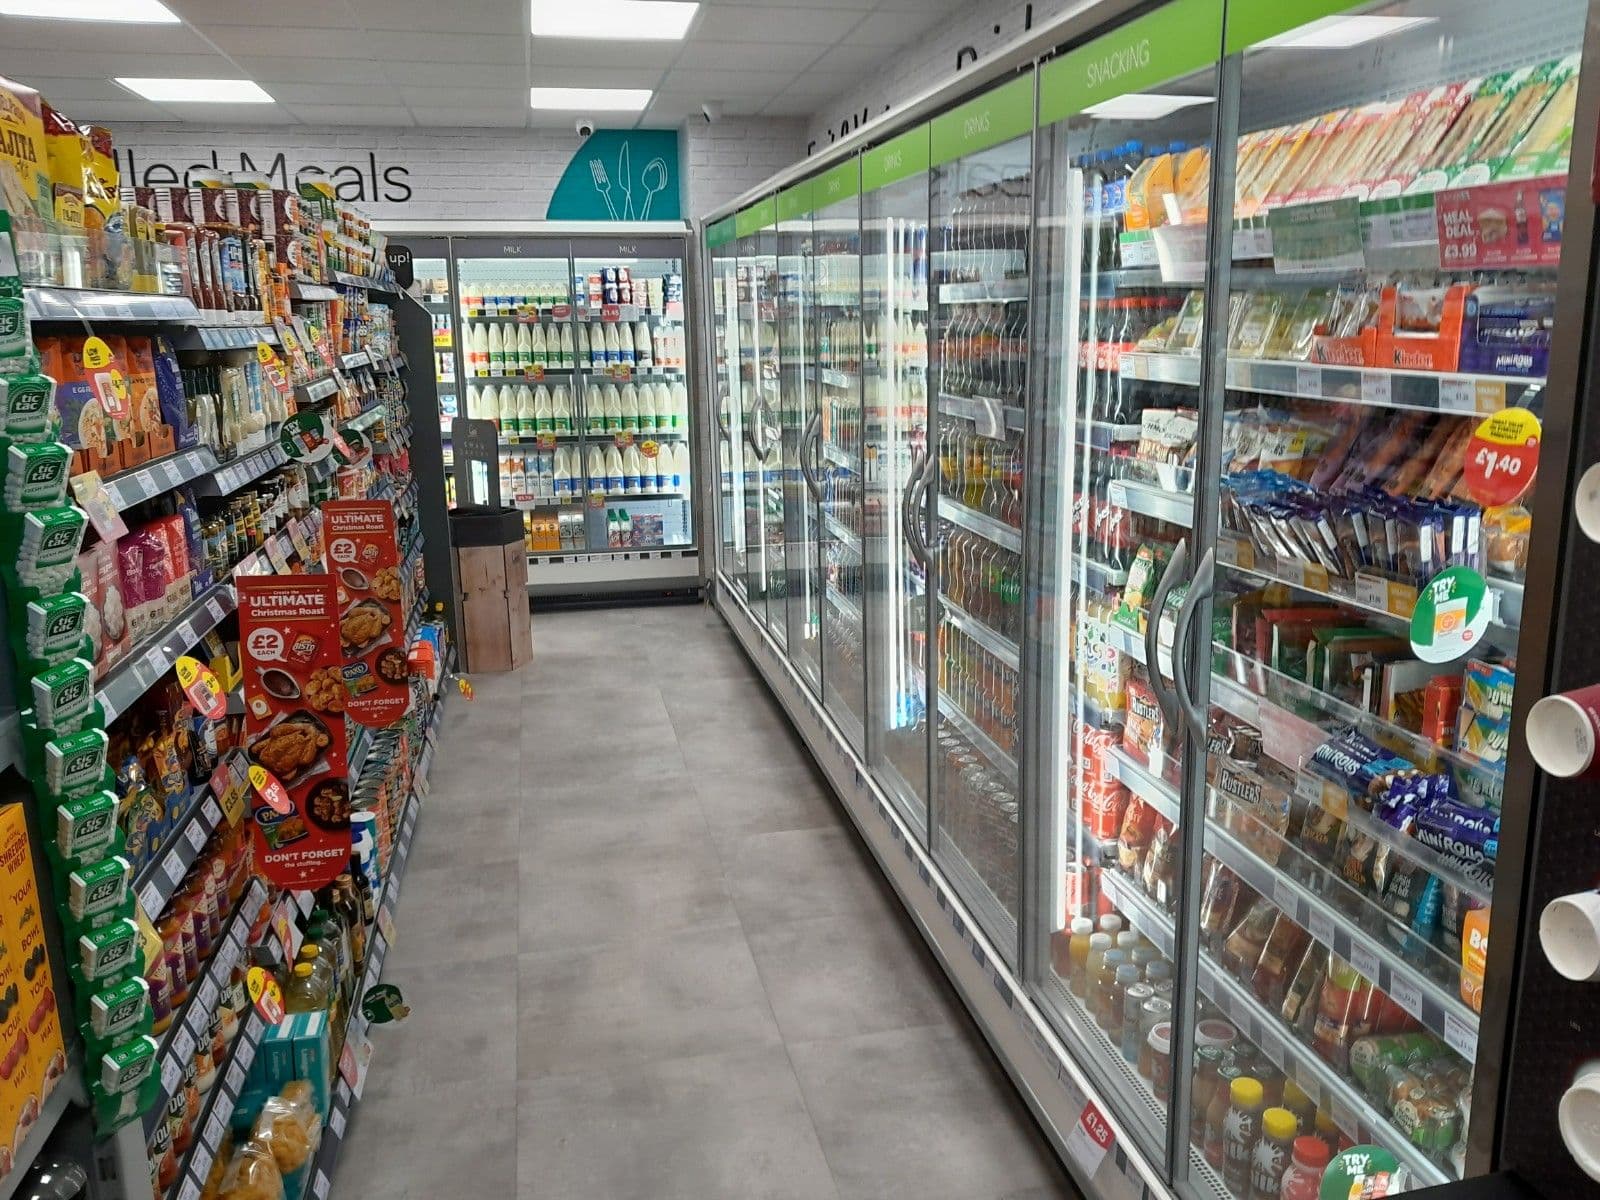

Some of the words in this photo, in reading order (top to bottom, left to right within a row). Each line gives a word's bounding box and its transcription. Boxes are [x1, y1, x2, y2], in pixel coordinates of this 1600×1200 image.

[1087, 39, 1150, 89] SNACKING
[1443, 208, 1474, 226] MEAL
[1445, 222, 1475, 239] DEAL
[503, 246, 522, 254] MILK
[619, 246, 637, 254] MILK
[389, 253, 410, 265] up!
[21, 393, 39, 404] tic
[16, 402, 38, 411] tac
[38, 464, 56, 474] tic
[1475, 447, 1521, 479] £1.40
[32, 472, 54, 481] tac
[331, 514, 384, 524] ULTIMATE
[48, 537, 68, 547] tac
[54, 531, 71, 541] tic
[333, 542, 352, 554] £2
[1432, 576, 1455, 592] TRY
[250, 594, 325, 607] ULTIMATE
[1434, 591, 1450, 604] ME
[251, 608, 297, 617] Christmas
[299, 607, 325, 615] Roast
[59, 614, 75, 626] tic
[53, 624, 73, 634] tac
[252, 634, 279, 649] £2
[343, 663, 365, 680] PAXO
[64, 684, 81, 695] tic
[59, 692, 79, 705] tac
[347, 700, 372, 708] DON'T
[374, 697, 404, 706] FORGET
[1131, 696, 1159, 721] RUSTLERS
[77, 754, 94, 764] tic
[71, 761, 92, 773] tac
[1221, 771, 1262, 803] RUSTLERS
[87, 817, 103, 828] tic
[81, 825, 101, 836] tac
[0, 831, 27, 867] SHREDDED
[264, 852, 298, 863] DON'T
[301, 848, 345, 860] FORGET
[7, 848, 26, 875] WHEAT
[13, 879, 32, 905] YOUR
[21, 924, 40, 951] BOWL
[30, 971, 48, 998] YOUR
[2, 1015, 21, 1042] YOUR
[40, 1021, 54, 1042] WAY
[13, 1065, 29, 1088] WAY
[1086, 1112, 1108, 1143] £1.25
[1343, 1153, 1370, 1167] TRY
[1346, 1165, 1364, 1175] ME
